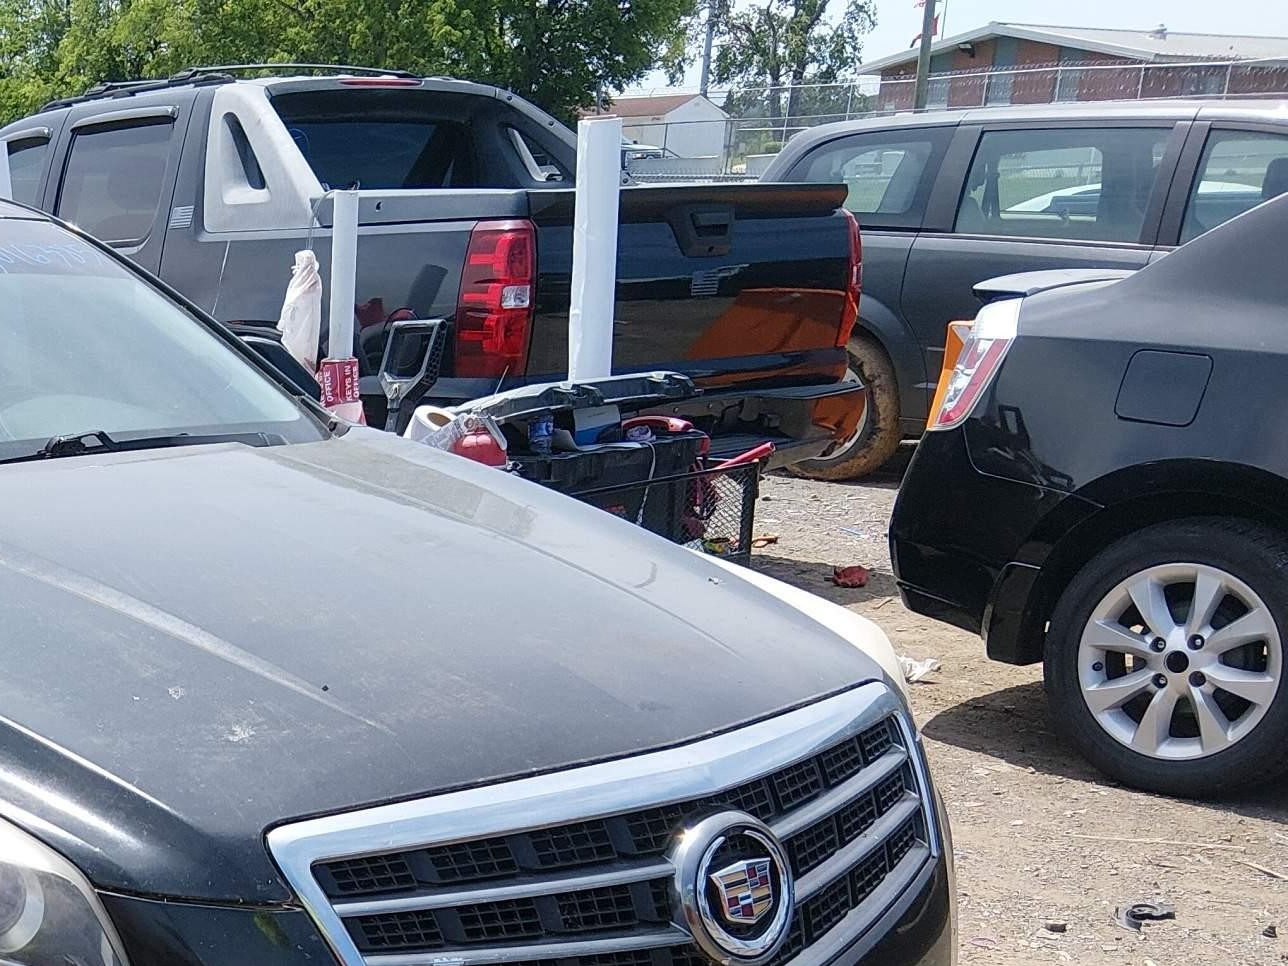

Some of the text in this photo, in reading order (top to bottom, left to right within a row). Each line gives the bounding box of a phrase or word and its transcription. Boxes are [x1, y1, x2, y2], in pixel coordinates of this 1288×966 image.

[323, 369, 334, 402] OFFICE
[344, 365, 353, 401] KEYS IN
